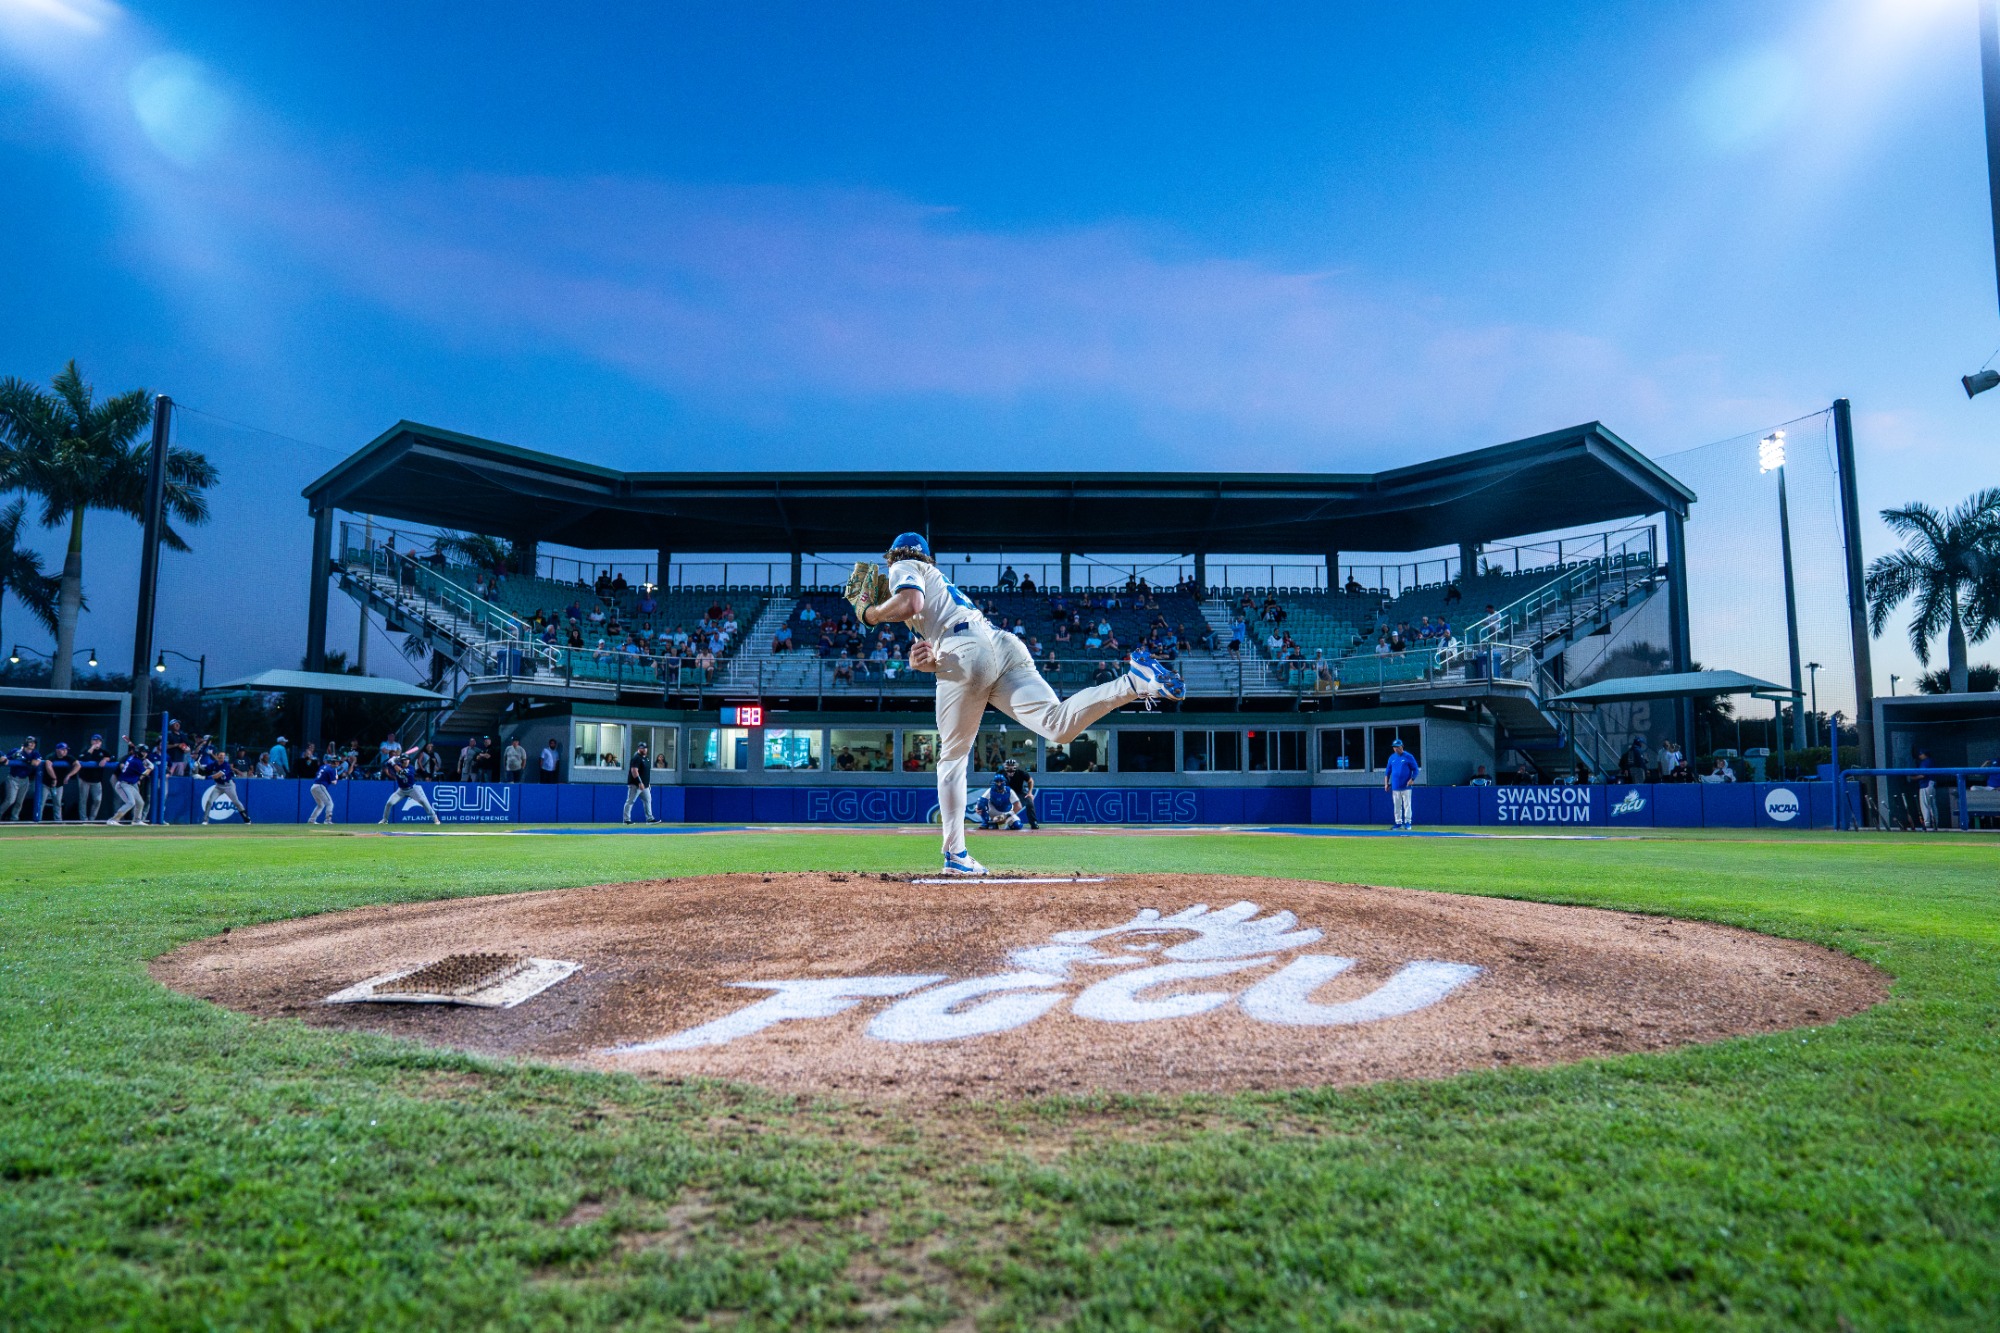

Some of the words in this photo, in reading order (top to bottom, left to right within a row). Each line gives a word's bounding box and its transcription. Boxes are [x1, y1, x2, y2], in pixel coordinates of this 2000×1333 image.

[1496, 787, 1591, 804] SWANSON
[807, 790, 917, 822] FGCU
[1042, 791, 1198, 823] EAGLES
[1498, 805, 1590, 822] STADIUM
[1611, 798, 1646, 816] FGCU
[1768, 804, 1798, 813] NCAA
[604, 952, 1484, 1056] FGCU
